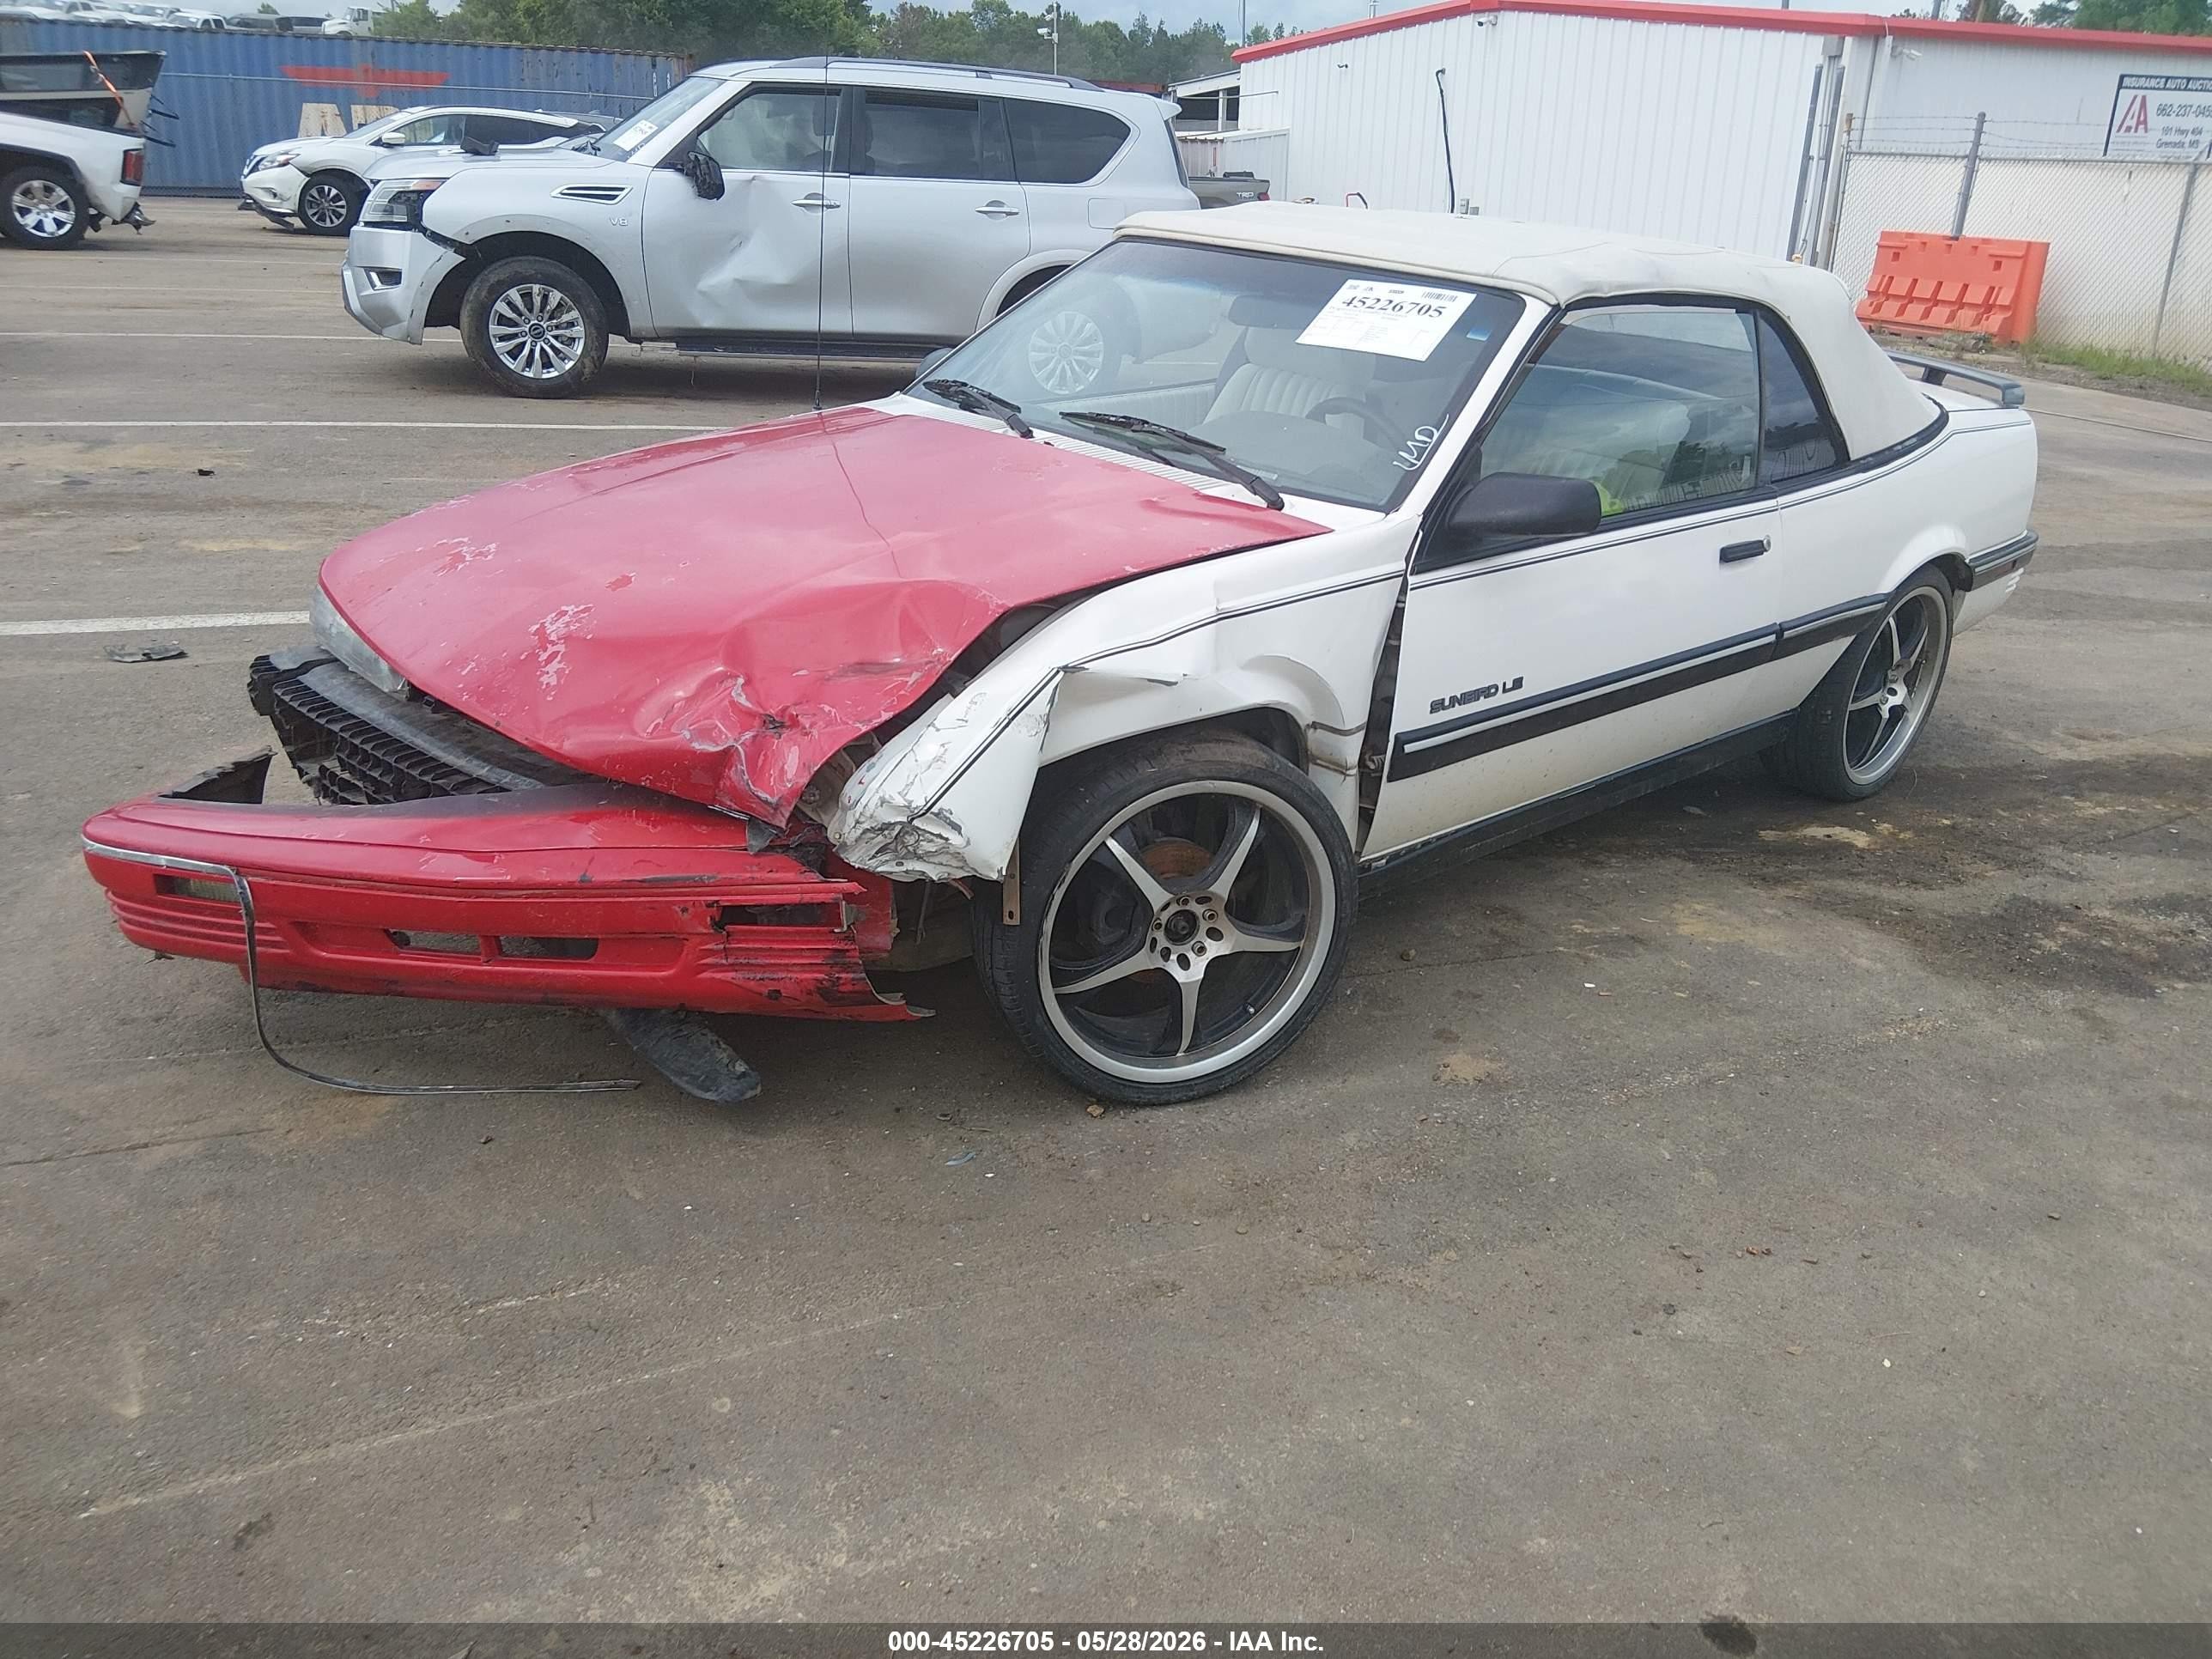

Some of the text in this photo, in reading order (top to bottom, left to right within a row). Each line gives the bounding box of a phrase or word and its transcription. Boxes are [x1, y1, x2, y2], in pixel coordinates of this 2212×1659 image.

[2123, 76, 2165, 88] INSURANCE
[2166, 79, 2187, 88] AUTO
[2173, 126, 2191, 139] Hwy
[609, 216, 629, 227] V8
[1342, 295, 1448, 319] 45226705
[1429, 684, 1499, 714] SUNBIRD
